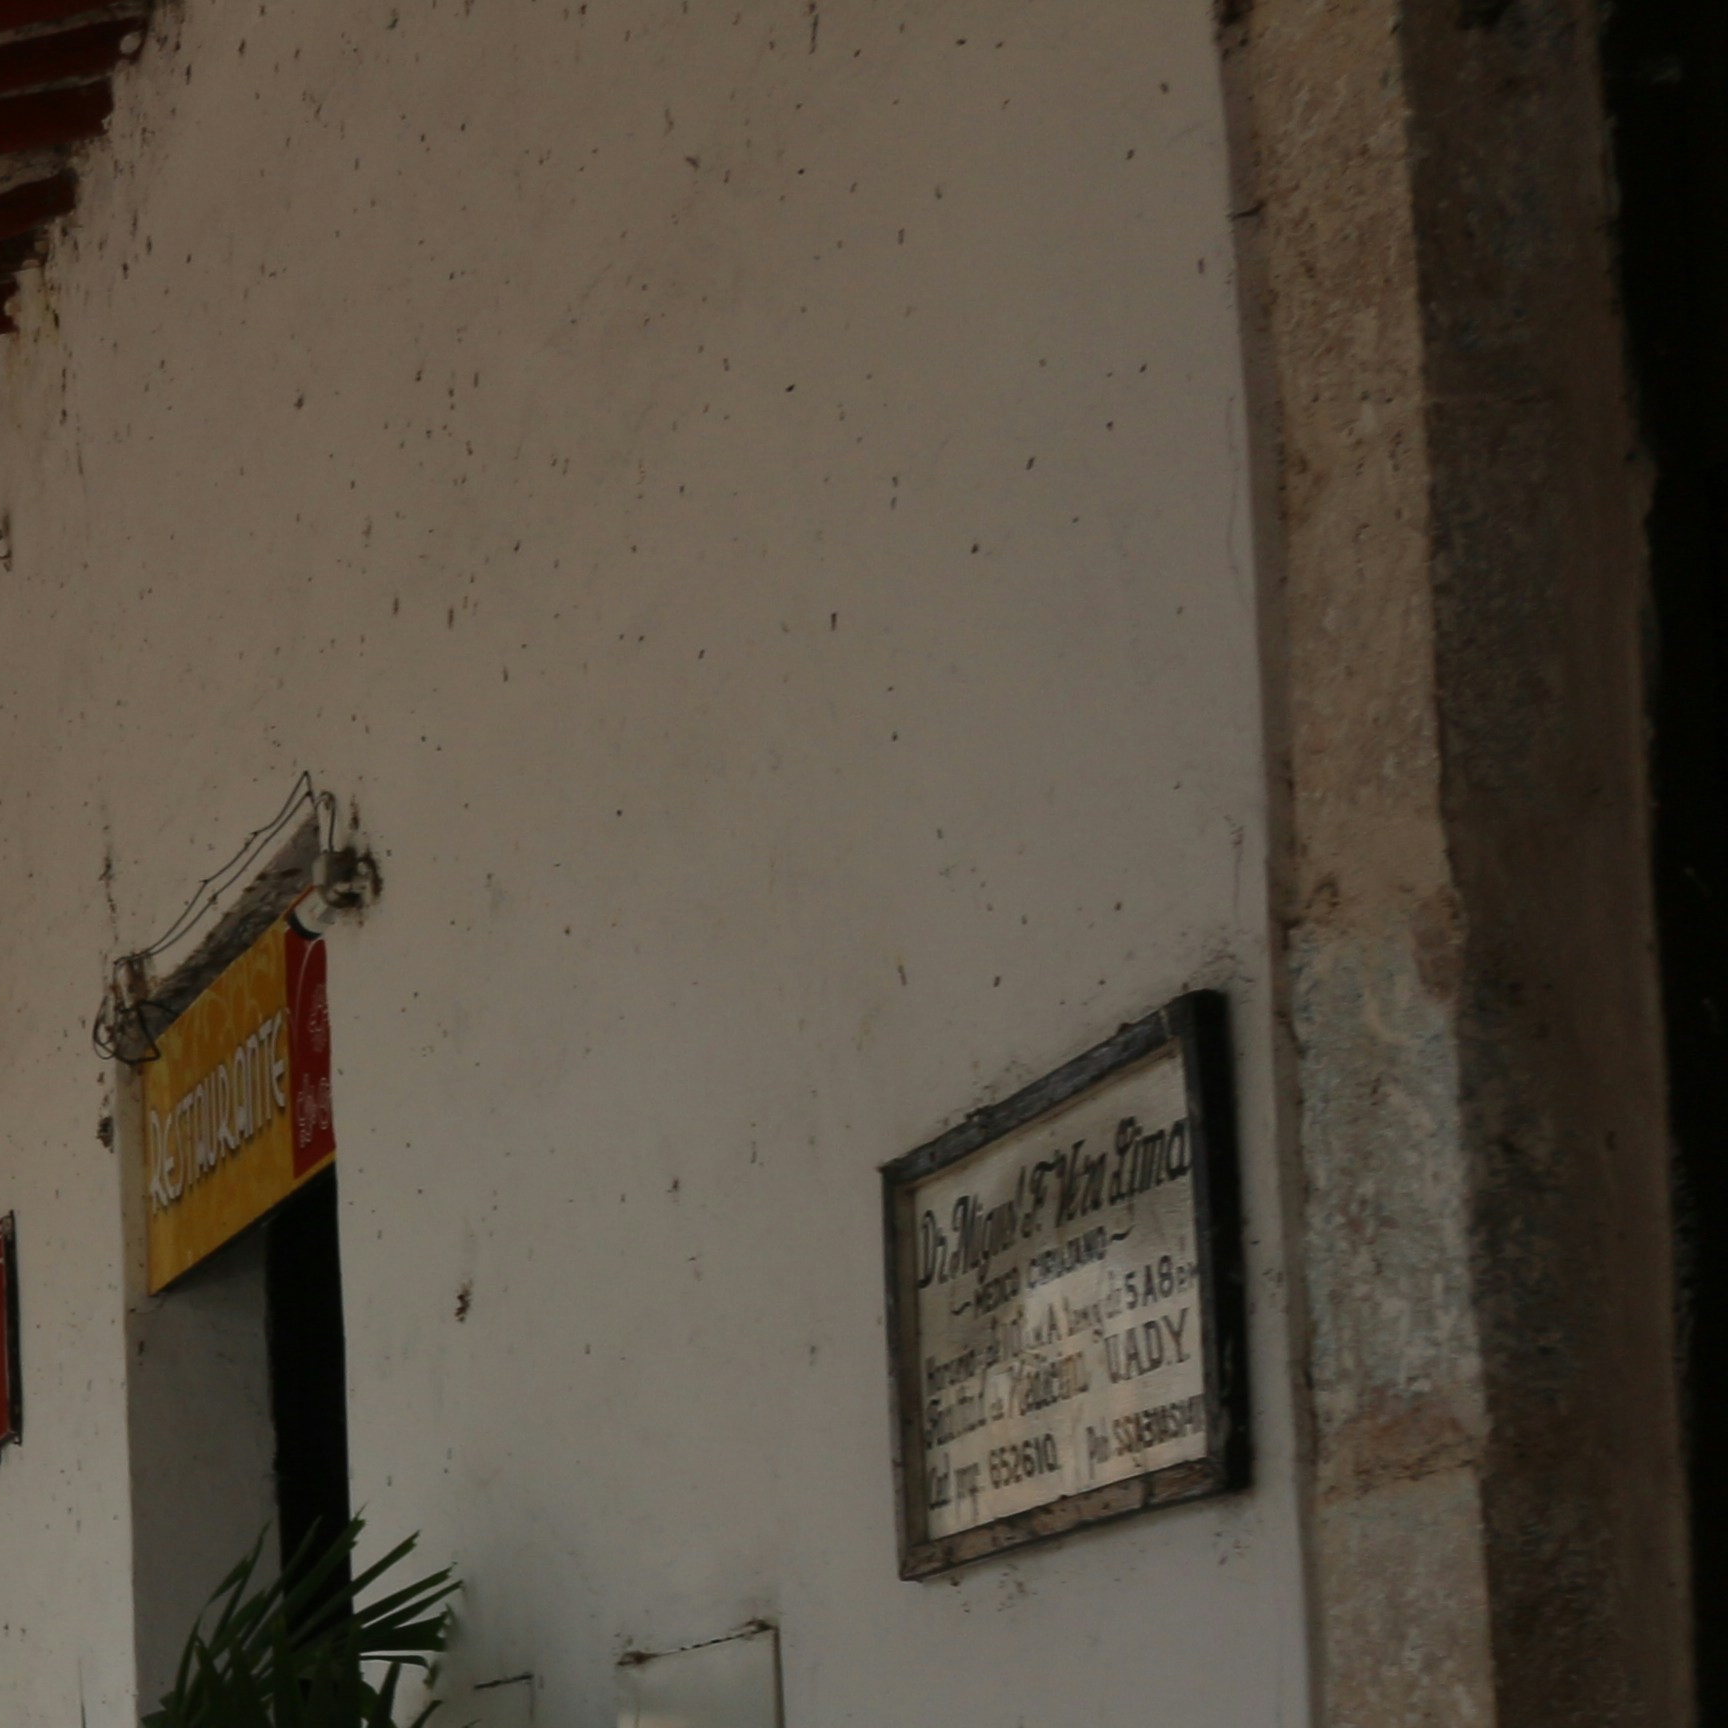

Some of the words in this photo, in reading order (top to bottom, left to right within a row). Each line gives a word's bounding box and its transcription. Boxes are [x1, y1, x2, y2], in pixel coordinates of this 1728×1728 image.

[149, 1010, 288, 1214] RESTAURANTE
[949, 1164, 1026, 1284] Miguel
[1108, 1115, 1191, 1206] Lima
